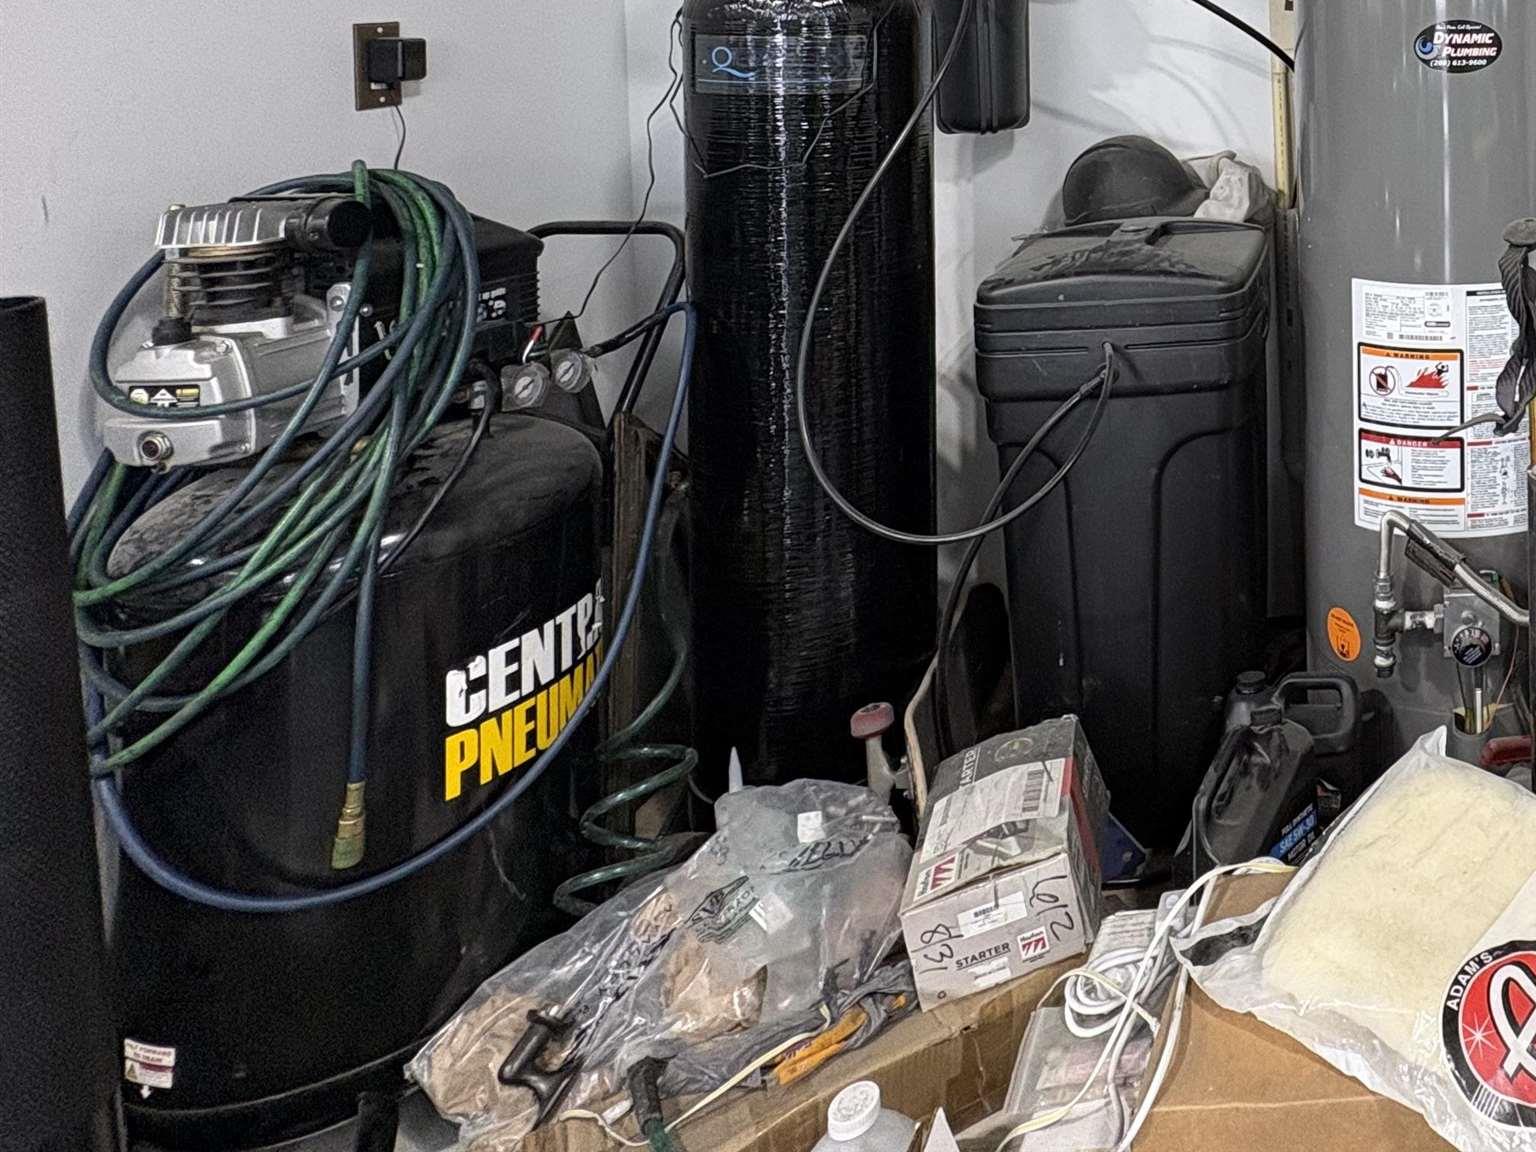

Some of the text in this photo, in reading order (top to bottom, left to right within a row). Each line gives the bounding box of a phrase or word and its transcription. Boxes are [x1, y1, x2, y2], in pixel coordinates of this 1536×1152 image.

[1433, 31, 1494, 45] DYNAMIC
[1442, 46, 1497, 57] PLUMBING
[1393, 352, 1431, 360] WARNING
[954, 942, 1011, 970] STARTER
[1446, 950, 1495, 1011] ADAM'S
